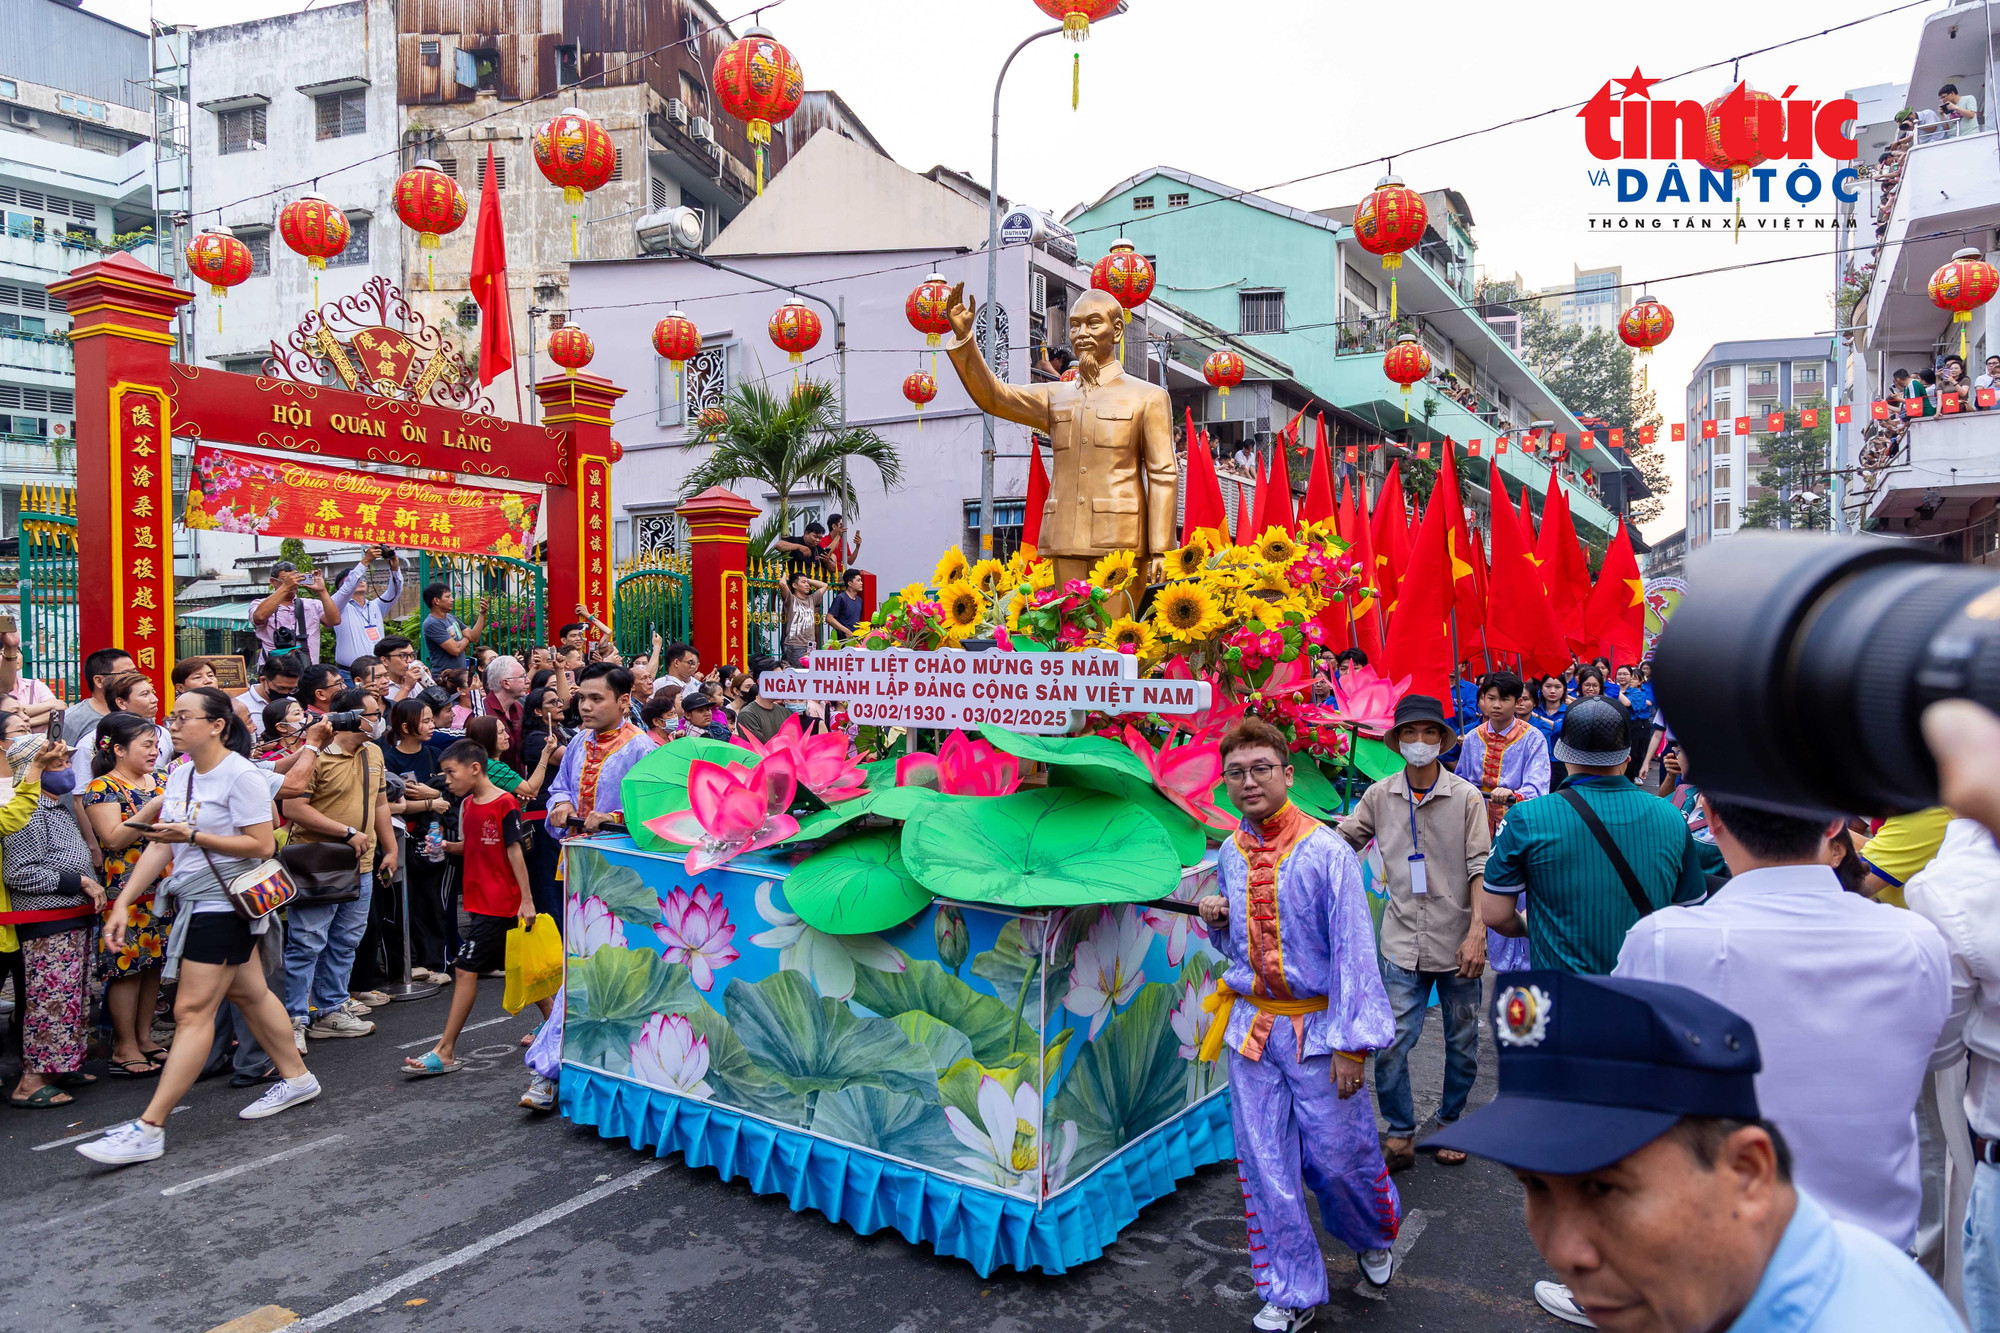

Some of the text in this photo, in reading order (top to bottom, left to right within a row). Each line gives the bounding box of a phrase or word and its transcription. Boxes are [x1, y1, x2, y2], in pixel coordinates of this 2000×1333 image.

[272, 401, 492, 453] HỘI QUÁN ÔN LĂNG
[279, 462, 486, 509] Chúc Mừng Năm Mới
[314, 498, 455, 534] 恭賀新禧
[131, 404, 158, 690] 陵谷滄桑過後越華同
[814, 654, 1119, 677] NHIỆT LIỆT CHÀO MỪNG 95 NĂM
[764, 675, 1194, 707] NGÀY THÀNH LẬP ĐẢNG CỘNG SẢN VIỆT NAM
[853, 703, 946, 721] 03/02/1930
[962, 707, 1067, 726] 03/02/2025
